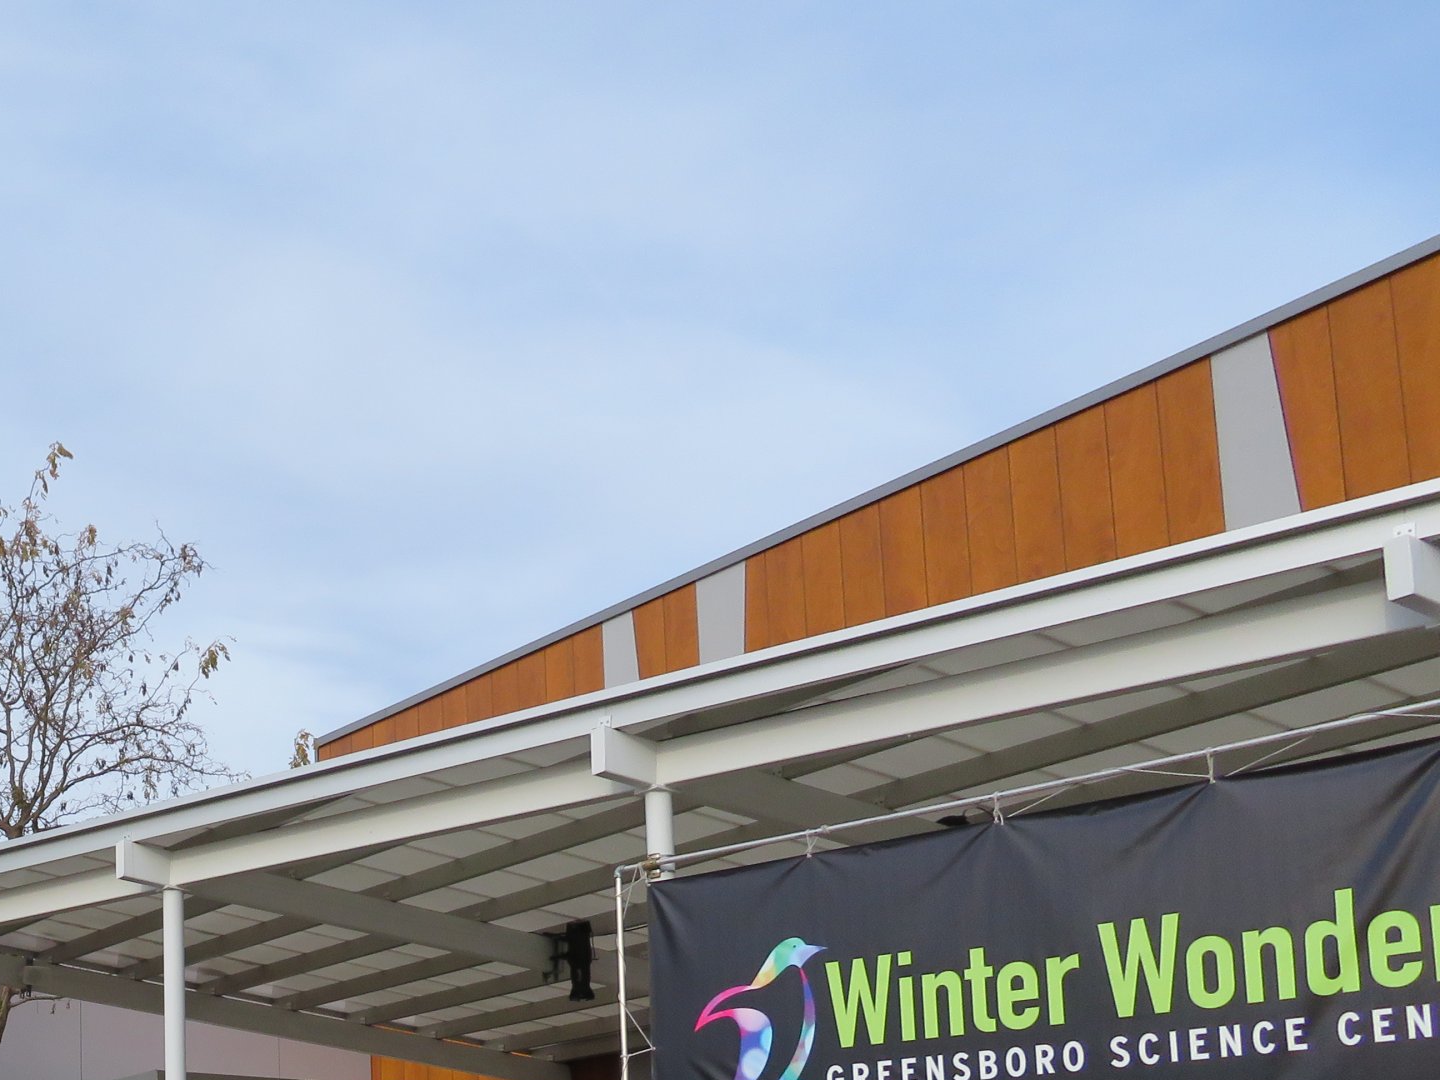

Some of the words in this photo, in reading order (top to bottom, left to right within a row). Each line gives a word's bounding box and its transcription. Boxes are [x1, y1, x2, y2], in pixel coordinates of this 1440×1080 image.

[825, 948, 1081, 1049] Winter
[1098, 888, 1440, 1019] Wonde
[1110, 1016, 1310, 1068] SCIENCE
[1336, 1003, 1433, 1046] CEN
